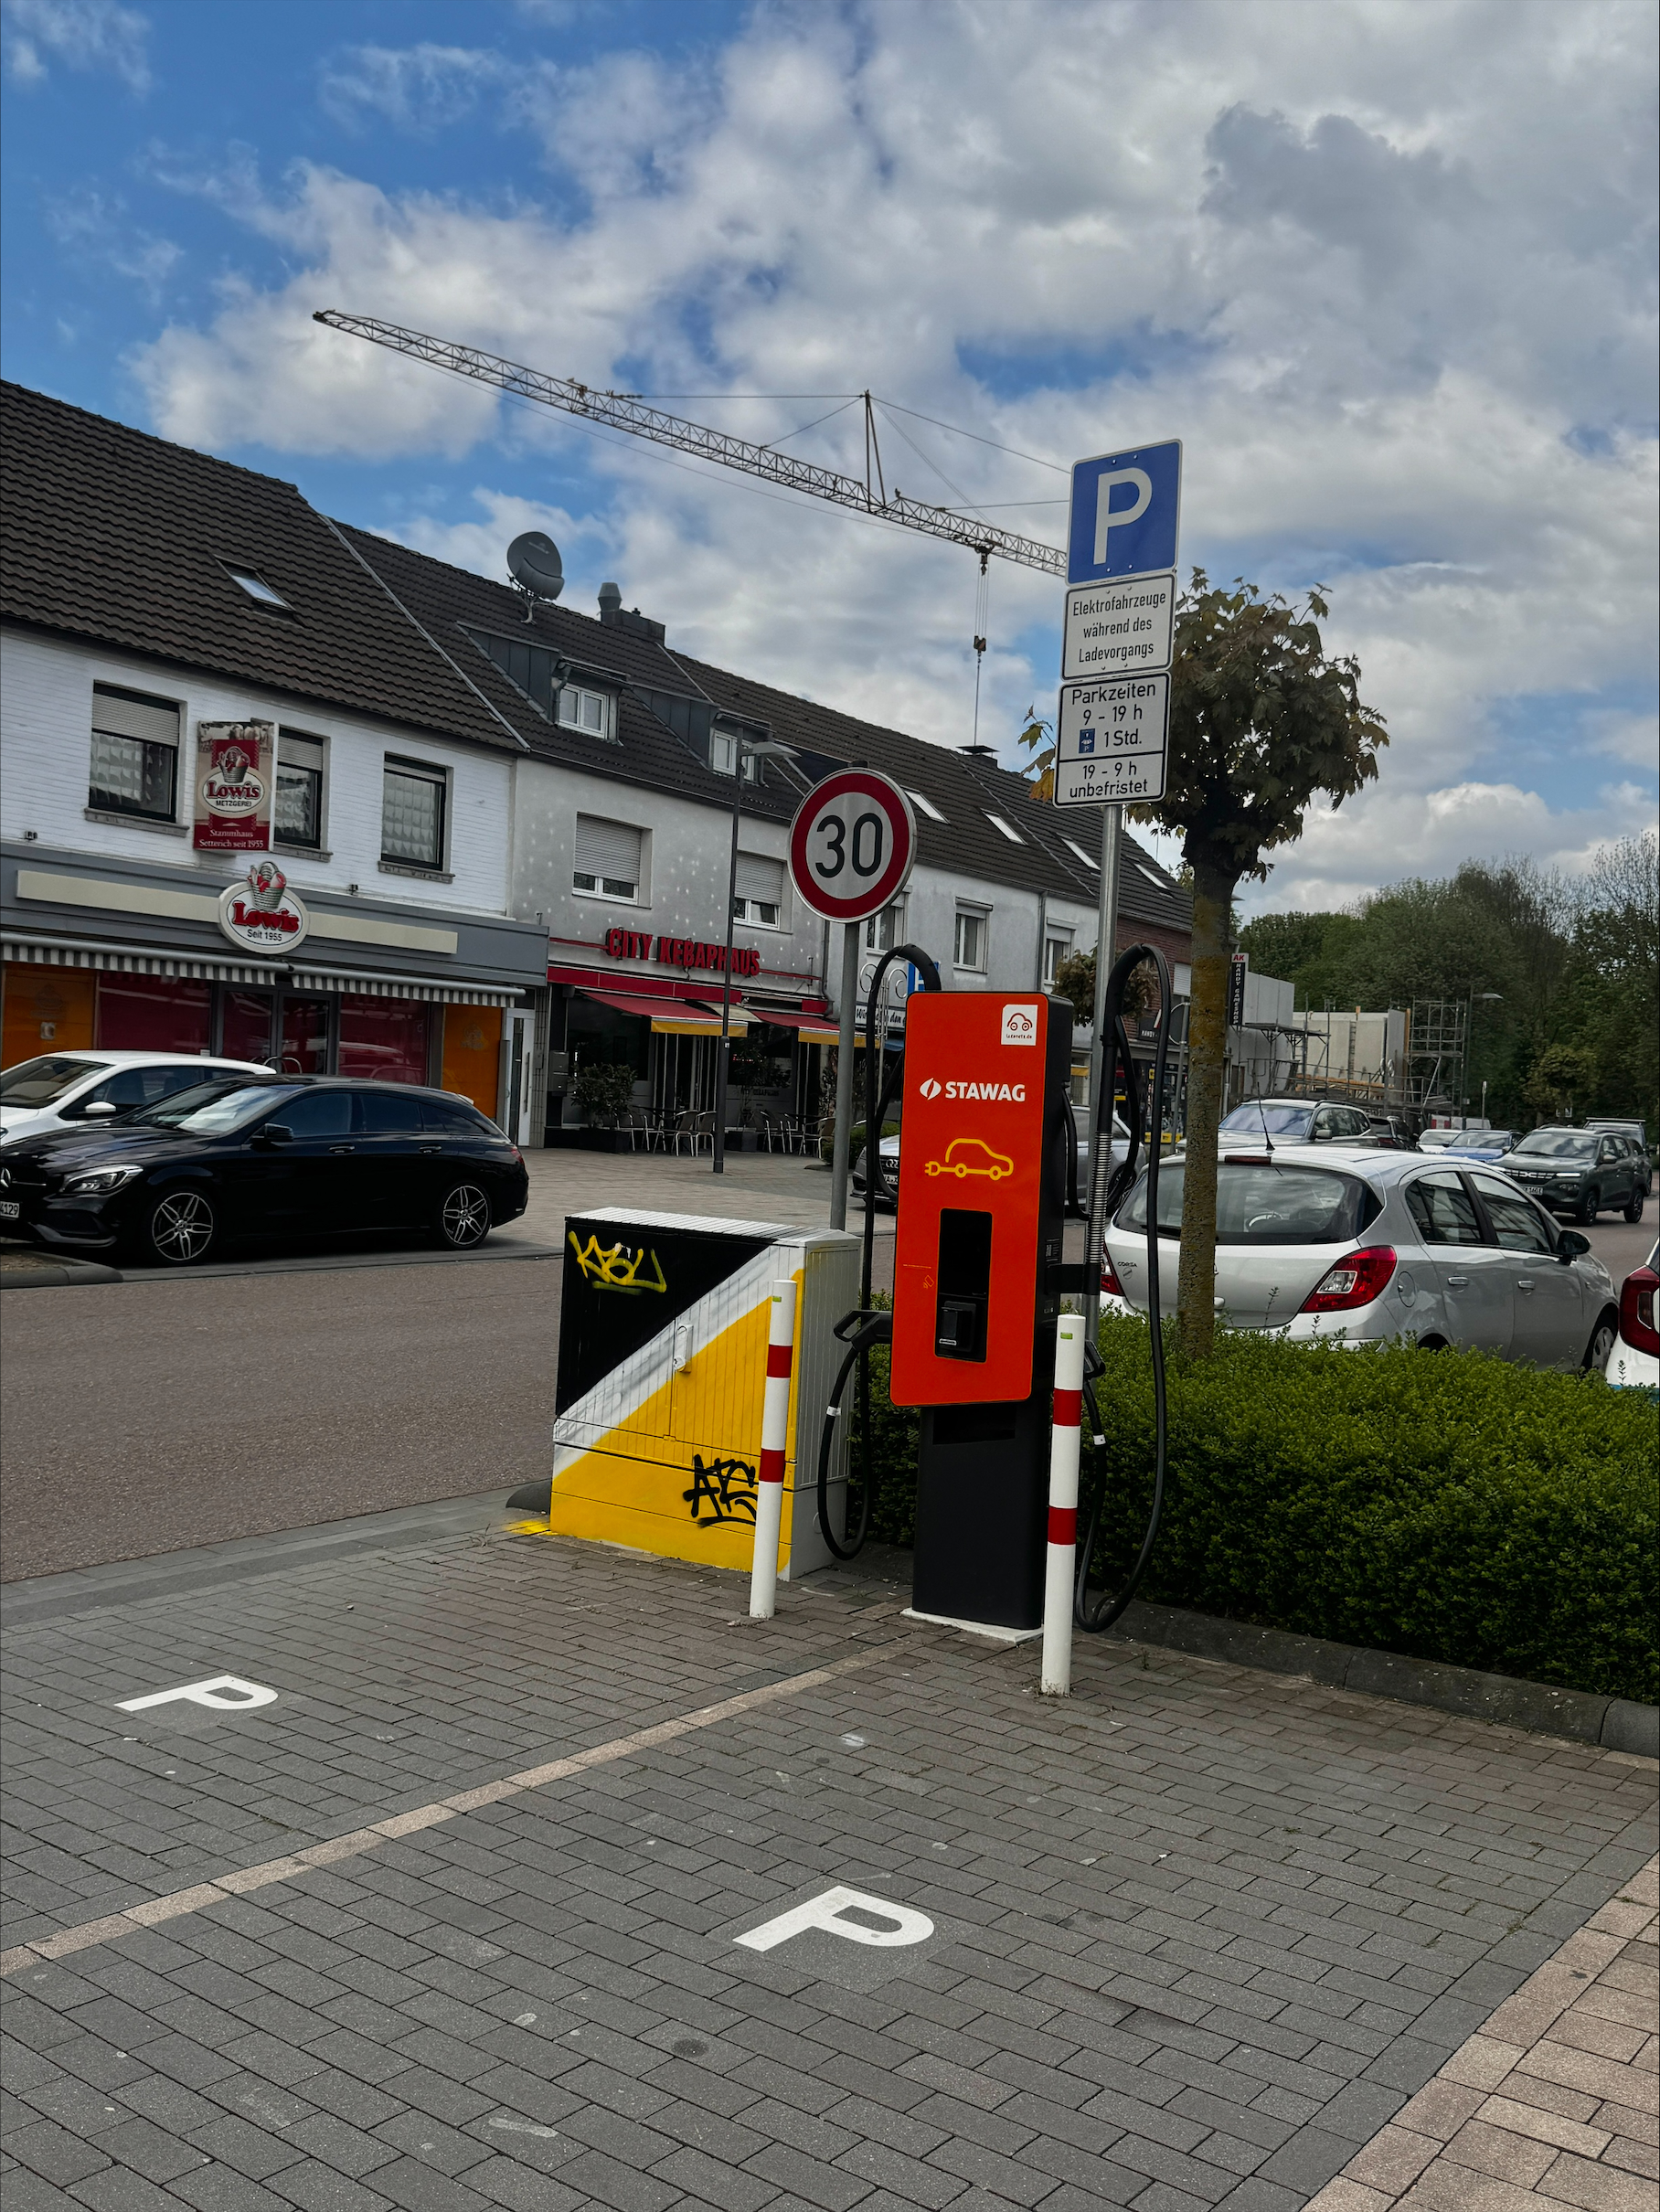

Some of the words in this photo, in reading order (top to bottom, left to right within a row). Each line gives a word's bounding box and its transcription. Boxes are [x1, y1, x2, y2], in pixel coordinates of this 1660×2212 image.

[1093, 467, 1152, 565] P
[1072, 592, 1166, 616] Elektrofahrzeuge
[1083, 618, 1129, 639] während
[1133, 617, 1152, 632] des
[1079, 642, 1154, 663] Ladevorgangs
[1071, 683, 1155, 705] Parkzeiten
[1083, 710, 1091, 725] 9
[1112, 706, 1127, 722] 19
[1133, 705, 1143, 720] h
[1104, 731, 1109, 747] 1
[1113, 728, 1142, 746] Std.
[1082, 764, 1095, 780] 19
[1114, 762, 1123, 777] 9
[1129, 761, 1137, 776] h
[207, 781, 261, 800] Lowis
[1069, 779, 1148, 798] unbefristet
[209, 829, 254, 838] Stammhaus
[233, 840, 247, 848] seit
[248, 840, 264, 848] 1955
[815, 813, 883, 878] 30
[232, 900, 300, 933] Lowis
[247, 929, 263, 939] Seit
[265, 931, 282, 941] 1955
[607, 928, 653, 960] CITY
[658, 936, 760, 976] KEBAPHAUS
[945, 1080, 1026, 1102] STAWAG
[113, 1675, 278, 1711] P
[732, 1885, 934, 1951] P
